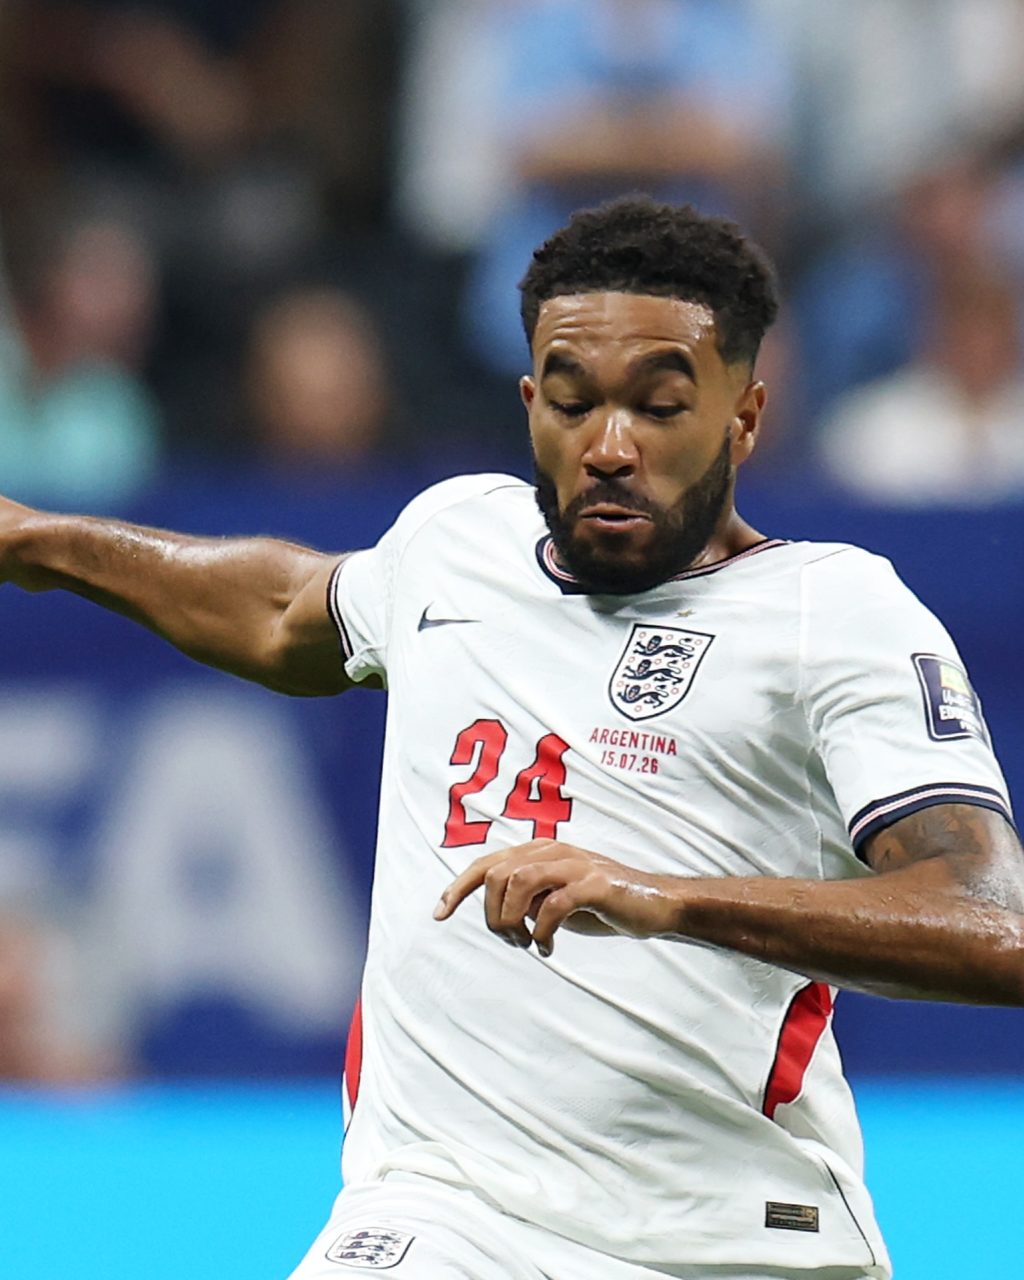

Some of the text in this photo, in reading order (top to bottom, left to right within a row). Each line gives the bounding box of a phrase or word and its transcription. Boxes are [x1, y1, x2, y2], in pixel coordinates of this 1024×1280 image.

[588, 727, 677, 756] ARGENTINA
[600, 750, 659, 775] 15.07.26
[440, 718, 573, 847] 24
